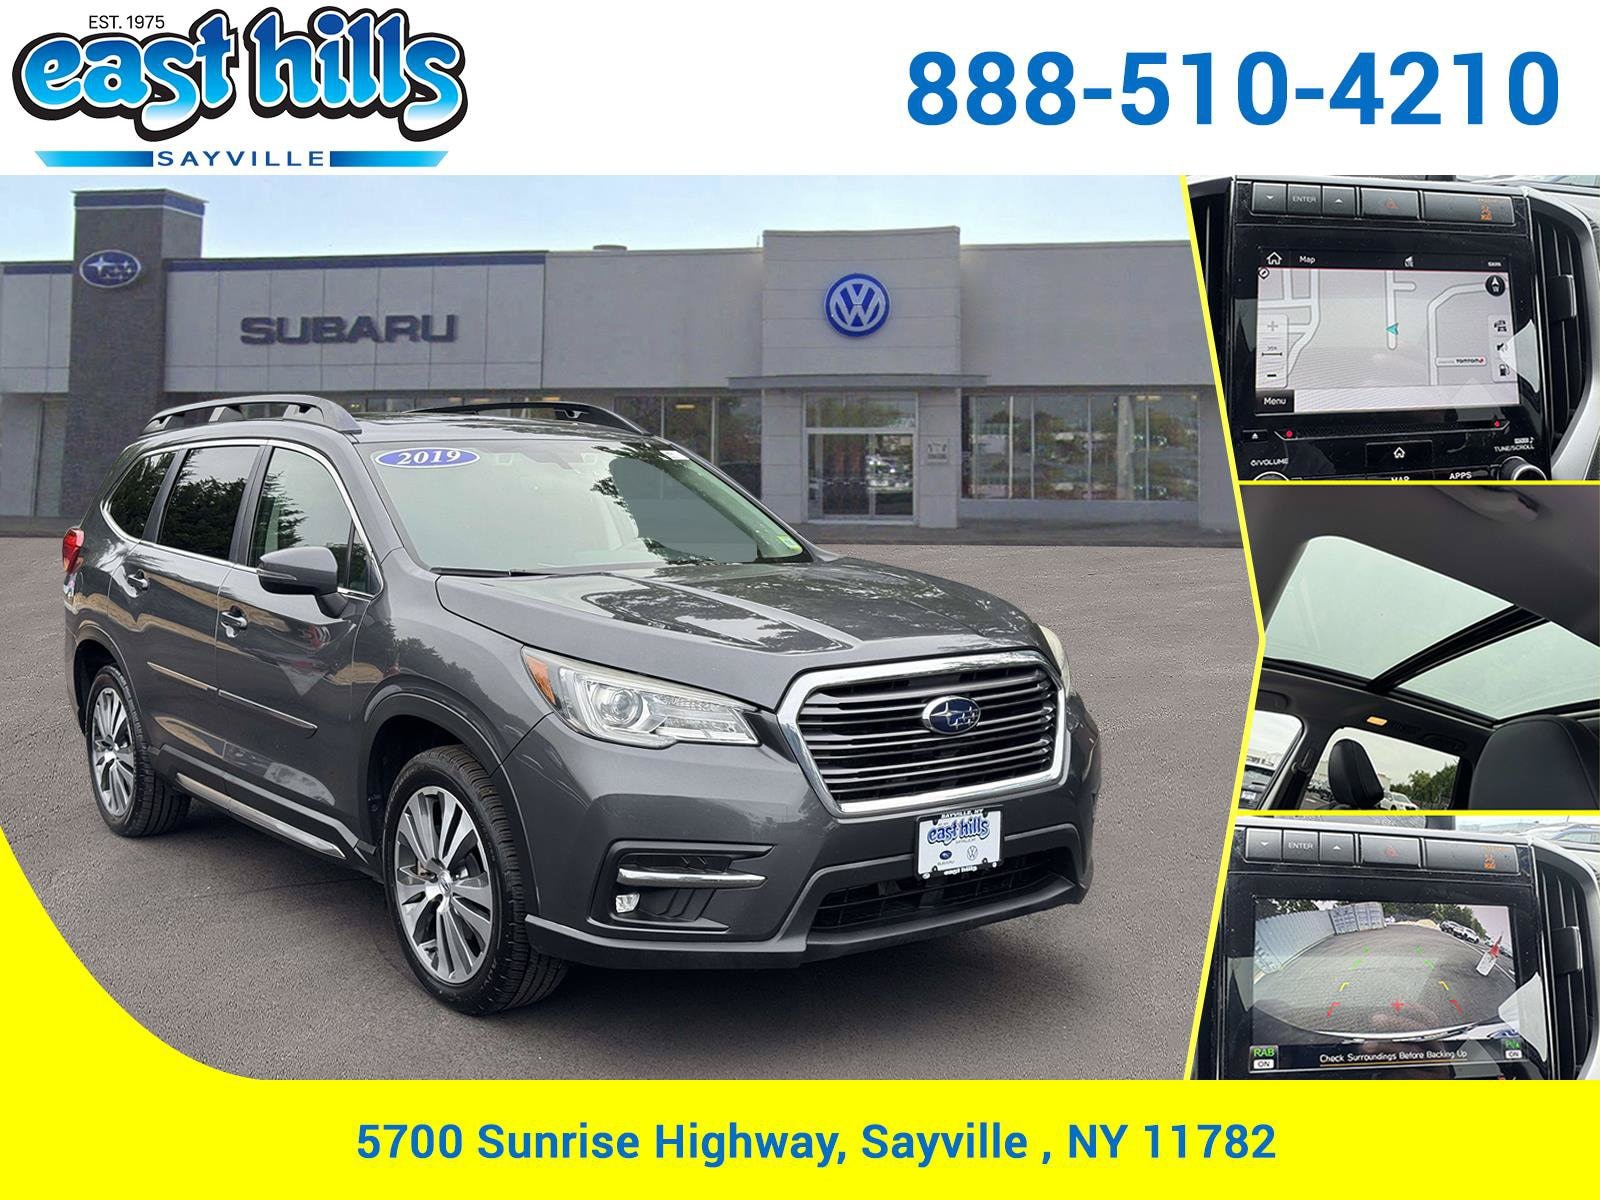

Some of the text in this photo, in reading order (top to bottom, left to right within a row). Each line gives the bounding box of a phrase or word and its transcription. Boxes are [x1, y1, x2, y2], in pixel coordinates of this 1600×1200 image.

[1292, 195, 1318, 204] ENTER
[1299, 255, 1317, 265] Map
[239, 314, 459, 346] SUBARU
[1263, 396, 1287, 406] Menu
[396, 450, 461, 465] 2019
[1448, 471, 1473, 480] APPS
[927, 815, 990, 846] east hills
[1287, 841, 1314, 850] ENTER
[1253, 1047, 1275, 1057] RAB
[1319, 1048, 1468, 1063] Check Surroundings Before Backing Up
